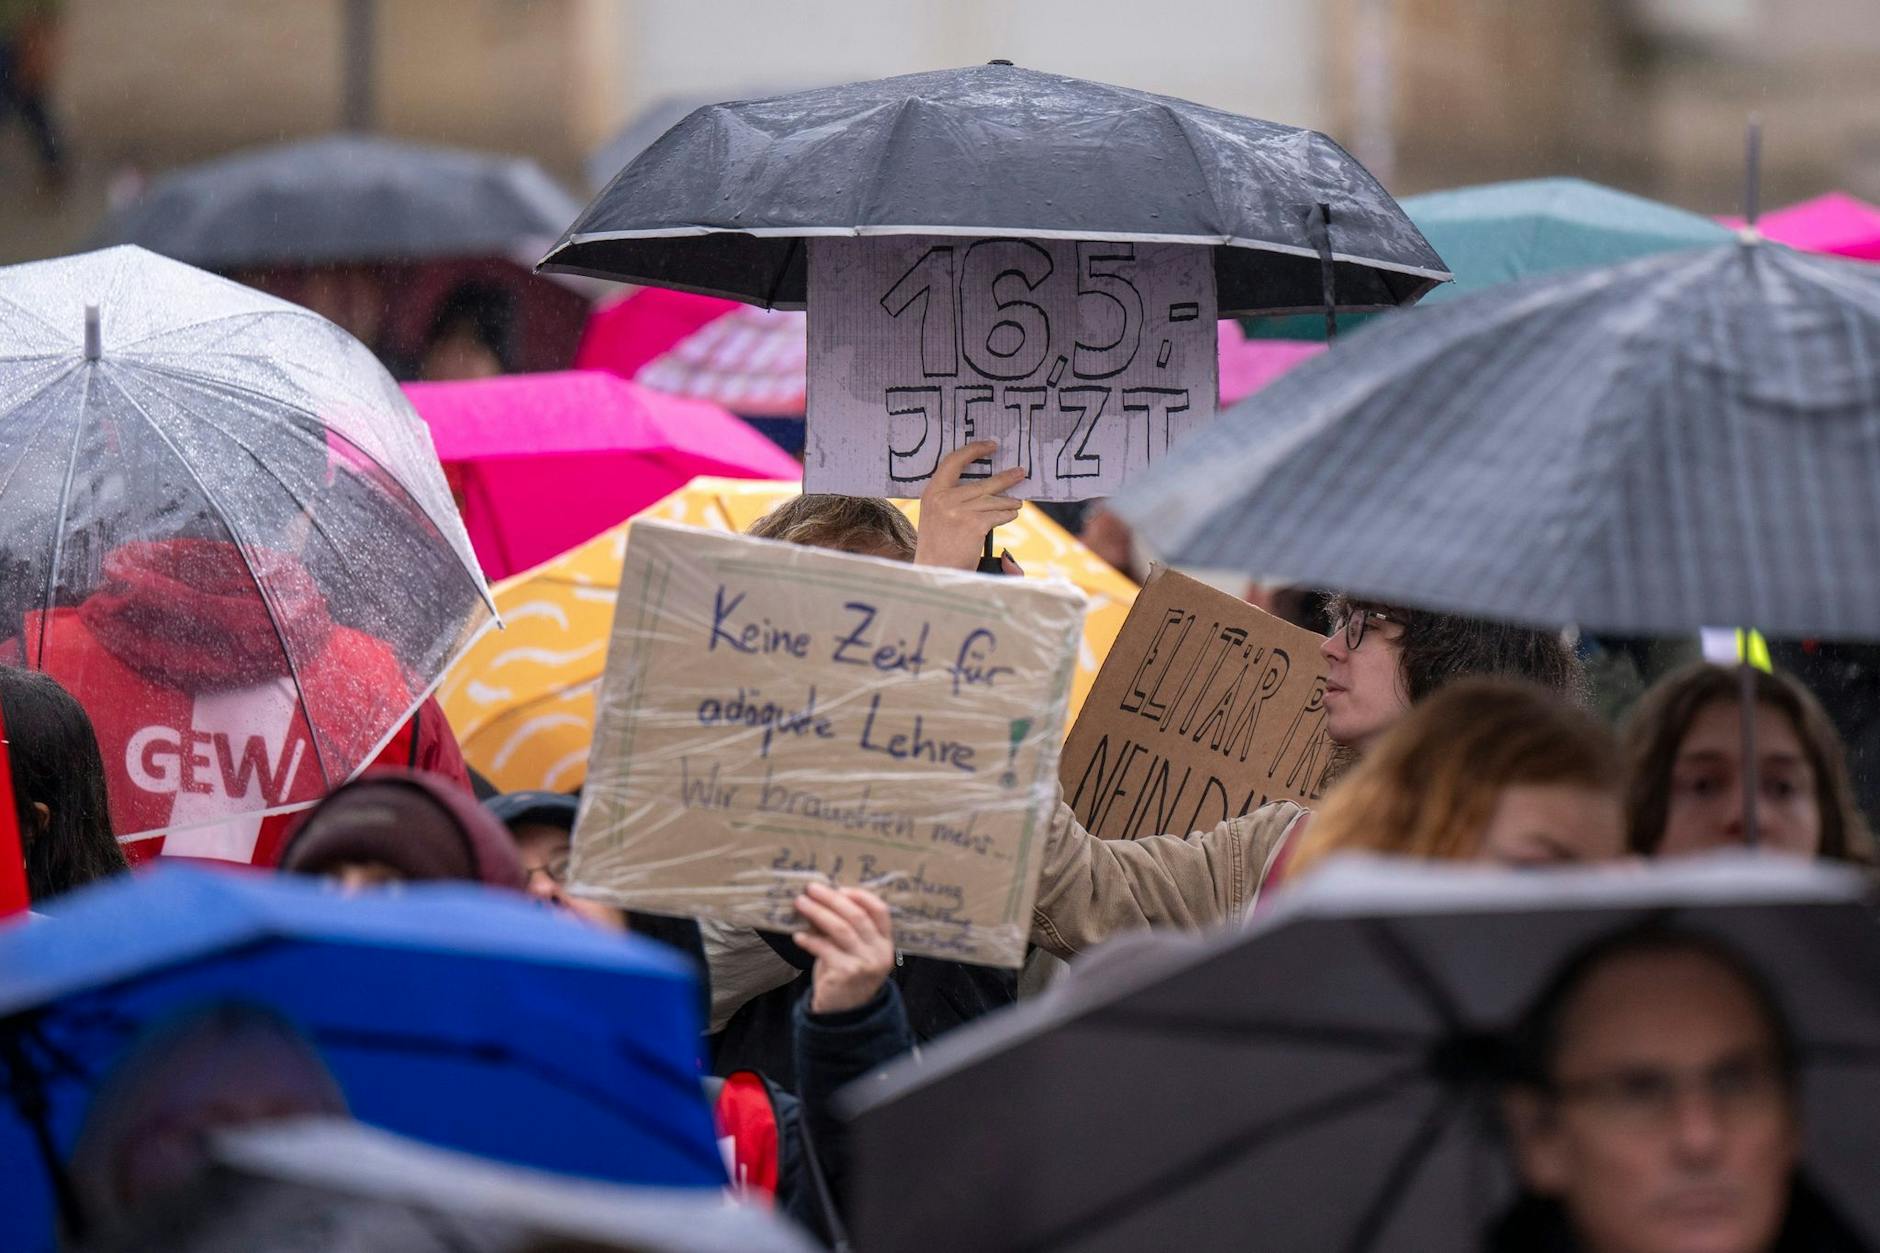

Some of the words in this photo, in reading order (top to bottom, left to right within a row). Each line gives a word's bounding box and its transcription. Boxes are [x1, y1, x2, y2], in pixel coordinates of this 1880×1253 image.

[885, 385, 1190, 481] JETZT
[709, 584, 810, 657] Keine
[832, 602, 929, 679] Zeit
[946, 628, 1014, 695] für
[1119, 607, 1291, 763] ELITÄR
[860, 693, 976, 772] Lehre
[681, 756, 737, 809] Wir
[756, 766, 915, 838] brauchen
[1071, 734, 1192, 841] NEIN
